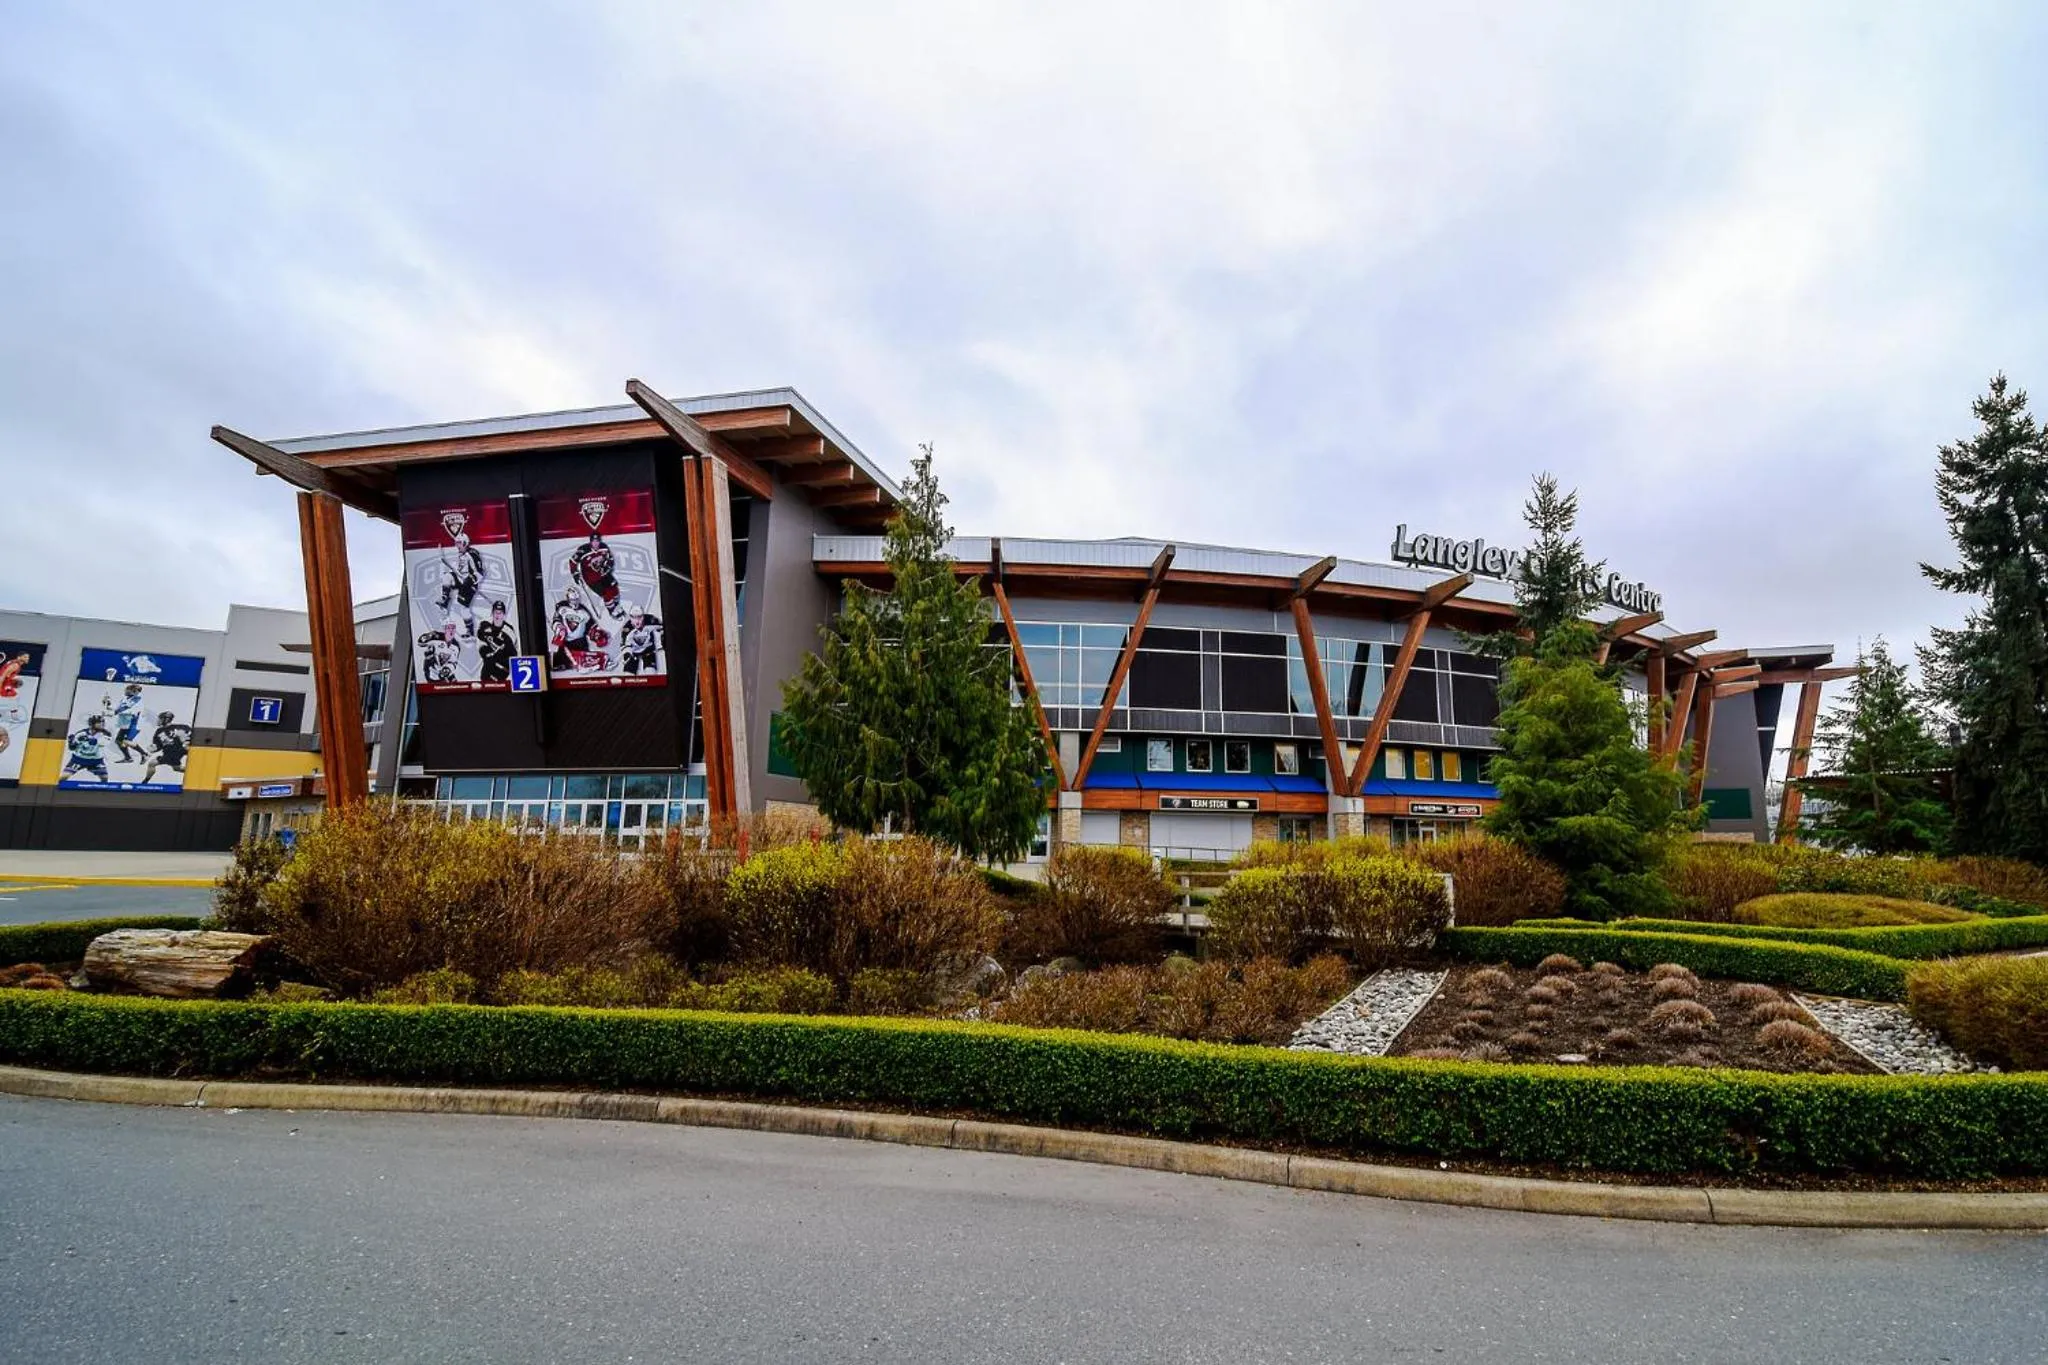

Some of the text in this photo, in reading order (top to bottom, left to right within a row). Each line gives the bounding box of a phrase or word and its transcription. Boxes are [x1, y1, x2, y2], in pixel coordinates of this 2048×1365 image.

[1397, 524, 1518, 578] Langley
[1607, 571, 1664, 612] Centre
[518, 666, 534, 689] 2
[260, 705, 271, 720] 1
[1190, 799, 1229, 809] TEAM STORE
